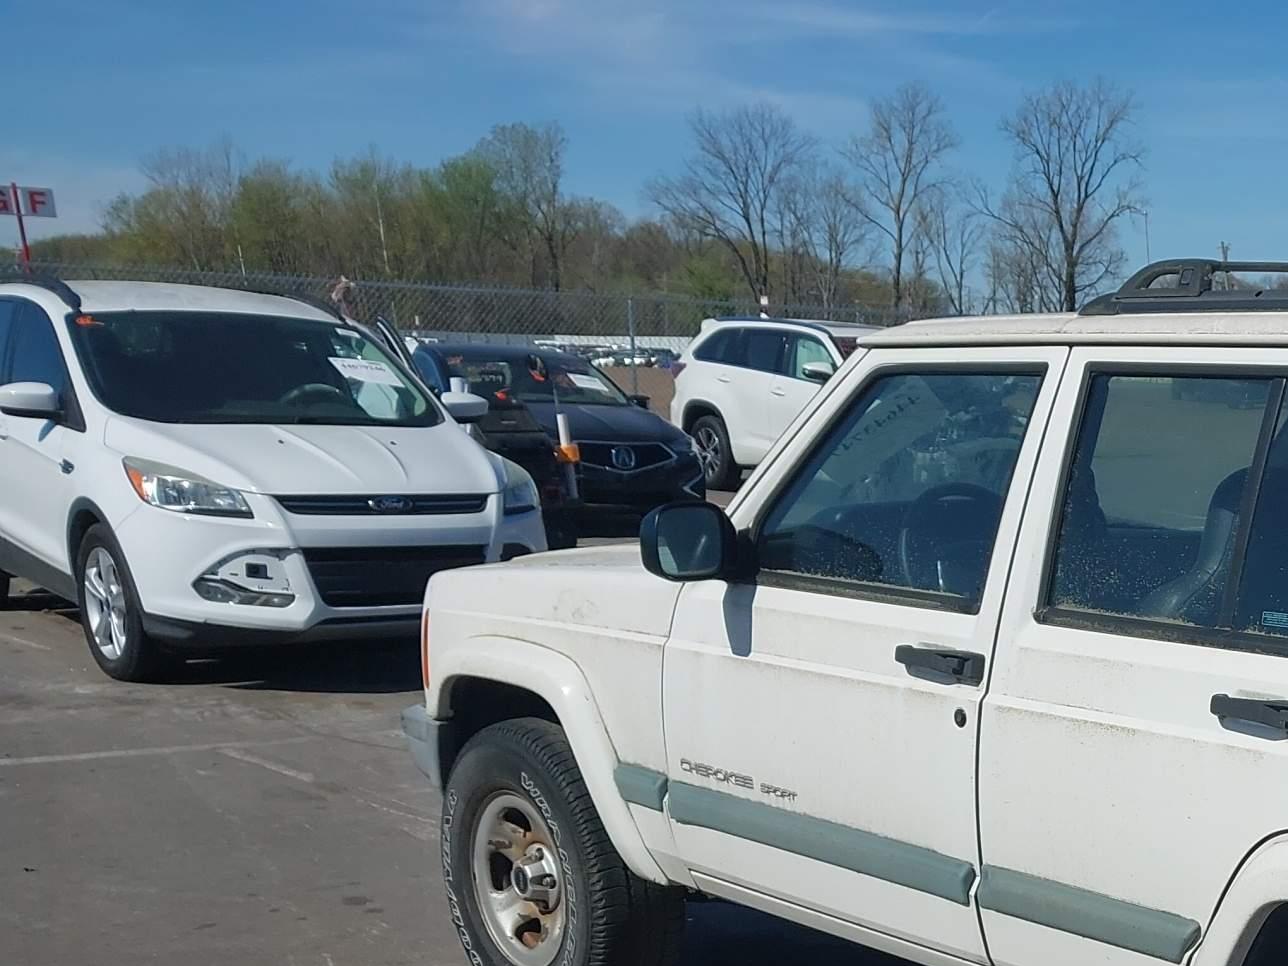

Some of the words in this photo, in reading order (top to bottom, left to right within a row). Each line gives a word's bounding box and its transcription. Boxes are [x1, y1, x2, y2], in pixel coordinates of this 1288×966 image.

[28, 191, 48, 214] F
[680, 758, 754, 790] CHEROKEE
[760, 783, 798, 801] SPORT
